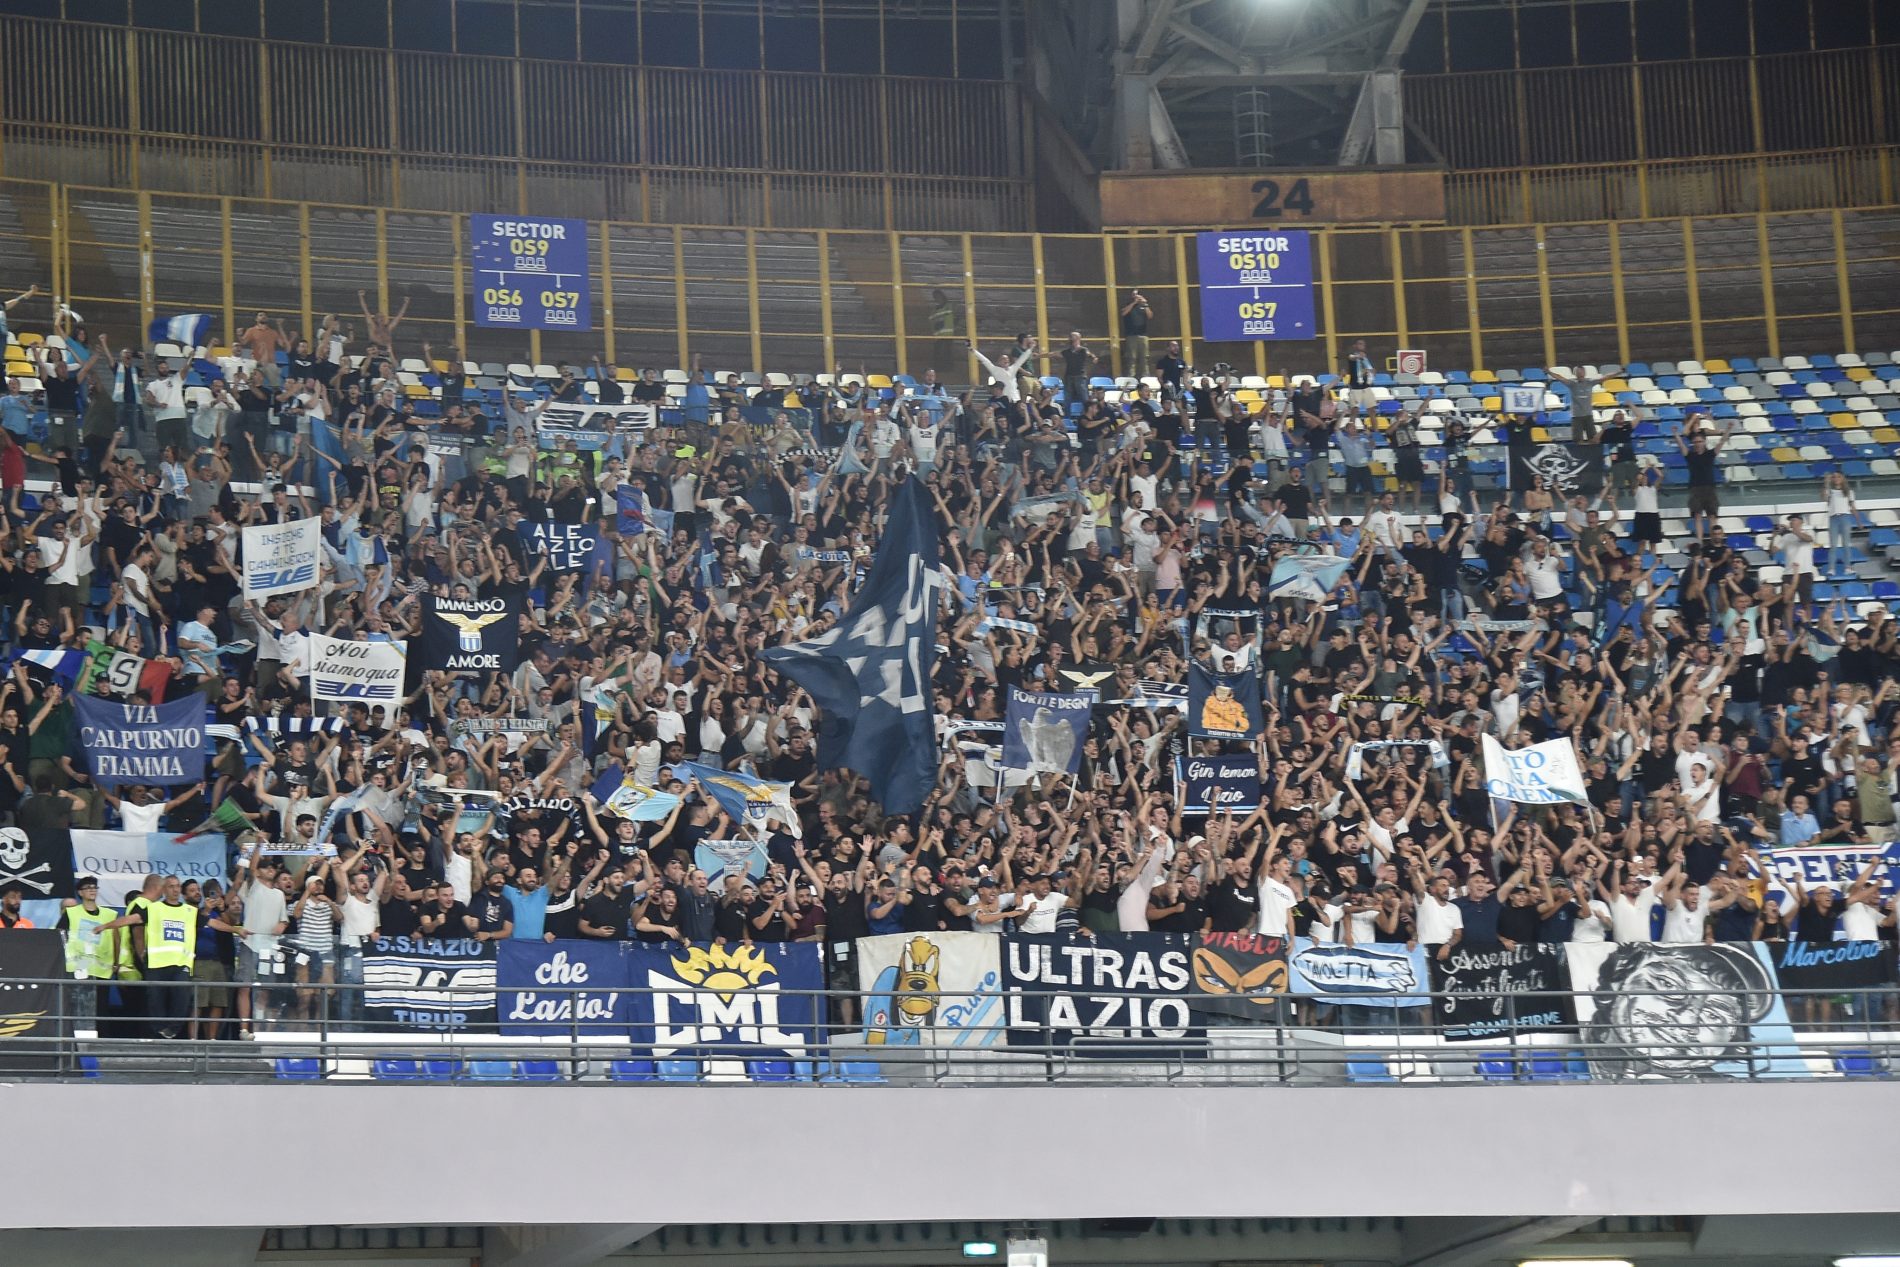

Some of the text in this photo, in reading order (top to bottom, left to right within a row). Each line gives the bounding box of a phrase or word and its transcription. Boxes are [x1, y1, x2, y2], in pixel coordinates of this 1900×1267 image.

[1251, 178, 1315, 217] 24
[492, 221, 566, 239] SECTOR
[510, 239, 549, 256] OS9
[1218, 237, 1289, 252] SECTOR
[1229, 253, 1280, 269] OS10
[483, 289, 579, 308] OS6 OS7
[1239, 302, 1277, 318] OS7
[435, 597, 506, 612] IMMENSO
[326, 642, 372, 659] Noi
[446, 654, 501, 669] AMORE
[122, 704, 159, 724] VIA
[80, 726, 201, 750] CALPURNIO
[96, 755, 185, 776] FIAMMA
[1188, 761, 1258, 781] Gin lemon
[83, 856, 221, 878] QUADRARO
[1779, 940, 1879, 968] Marcolino
[534, 951, 589, 984] che
[1009, 942, 1190, 990] ULTRAS
[509, 989, 619, 1020] Lazio!
[1009, 987, 1190, 1038] LAZIO
[393, 1009, 468, 1030] TIBUR
